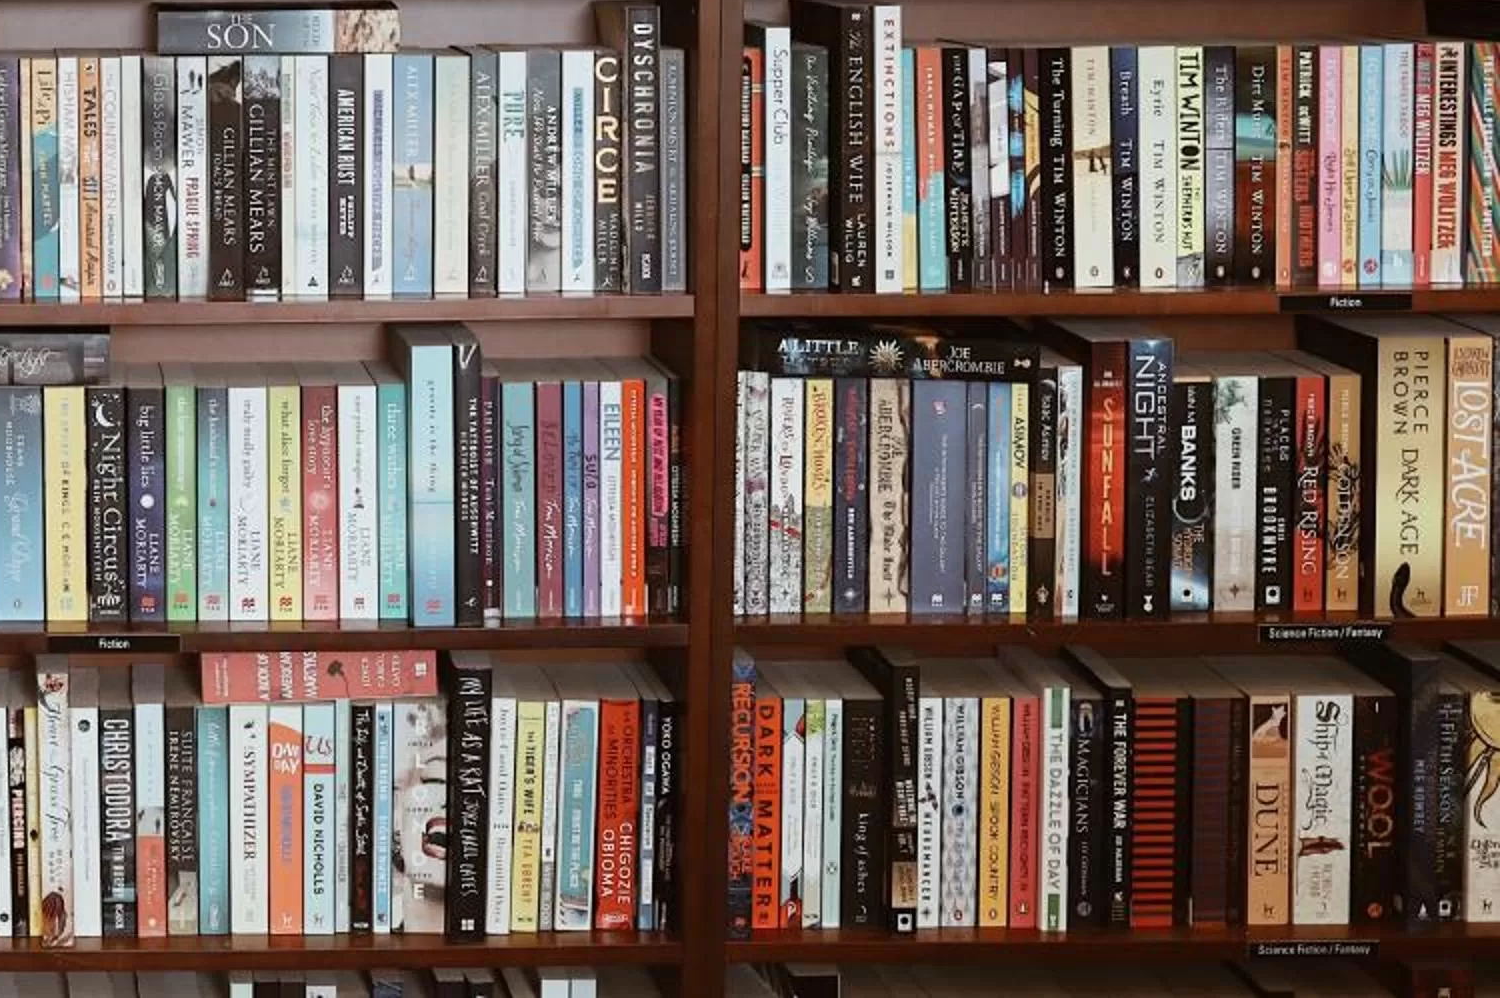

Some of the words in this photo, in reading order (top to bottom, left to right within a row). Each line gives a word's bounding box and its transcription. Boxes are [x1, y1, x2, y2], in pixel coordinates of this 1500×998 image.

[208, 23, 276, 48] SON
[634, 24, 655, 173] DYSCHRONIA
[774, 49, 788, 103] Supper
[884, 19, 895, 148] EXTINCTIONS
[1052, 58, 1063, 84] The
[1180, 52, 1199, 85] TIM
[338, 89, 355, 149] AMERICAN
[596, 57, 617, 202] CIRCE
[774, 108, 787, 145] Club
[847, 57, 862, 146] ENGLISH
[1050, 90, 1063, 148] Turning
[1180, 90, 1199, 171] WINTON
[249, 104, 264, 189] GILLIAN
[338, 156, 355, 186] RUST
[1053, 155, 1063, 184] TIM
[848, 154, 863, 205] WIFE
[250, 190, 265, 253] MEARS
[1054, 192, 1064, 258] WINTON
[1331, 298, 1361, 307] Fiction
[914, 358, 1004, 374] ABERCROMBIE
[949, 346, 971, 359] JOE
[138, 406, 155, 427] big
[1135, 355, 1155, 458] NIGHT
[1393, 351, 1407, 435] BROWN
[1414, 351, 1428, 434] PIERCE
[1453, 381, 1488, 458] LOST
[140, 430, 153, 471] little
[604, 403, 620, 460] EILEEN
[98, 432, 119, 501] Night
[1102, 399, 1112, 576] SUNFALL
[1181, 426, 1195, 502] BANKS
[1299, 466, 1317, 504] RED
[1396, 448, 1418, 504] DARK
[1452, 451, 1485, 548] ACRE
[100, 502, 119, 581] Circus
[1299, 511, 1316, 575] RISING
[1401, 511, 1418, 555] AGE
[99, 639, 129, 648] Fiction
[1269, 628, 1306, 638] Science
[1308, 629, 1338, 638] Fiction
[1346, 628, 1382, 639] Fantasy
[757, 705, 773, 776] DARK
[1113, 714, 1127, 737] THE
[104, 719, 131, 842] CHRISTODORA
[1074, 739, 1091, 833] MAGICIANS
[1113, 740, 1127, 796] FOREVER
[244, 750, 256, 861] SYMPATHIZER
[314, 783, 323, 825] DAVID
[1113, 800, 1127, 829] WAR
[1254, 783, 1278, 876] DUNE
[1367, 750, 1393, 858] WOOL
[313, 830, 324, 895] NICHOLLS
[602, 830, 615, 897] OBIOMA
[618, 824, 632, 904] CHIGOZIE
[757, 800, 772, 903] MATTER
[1258, 944, 1295, 955] Science
[1298, 945, 1327, 955] Fiction
[1335, 944, 1370, 955] Fantasy
